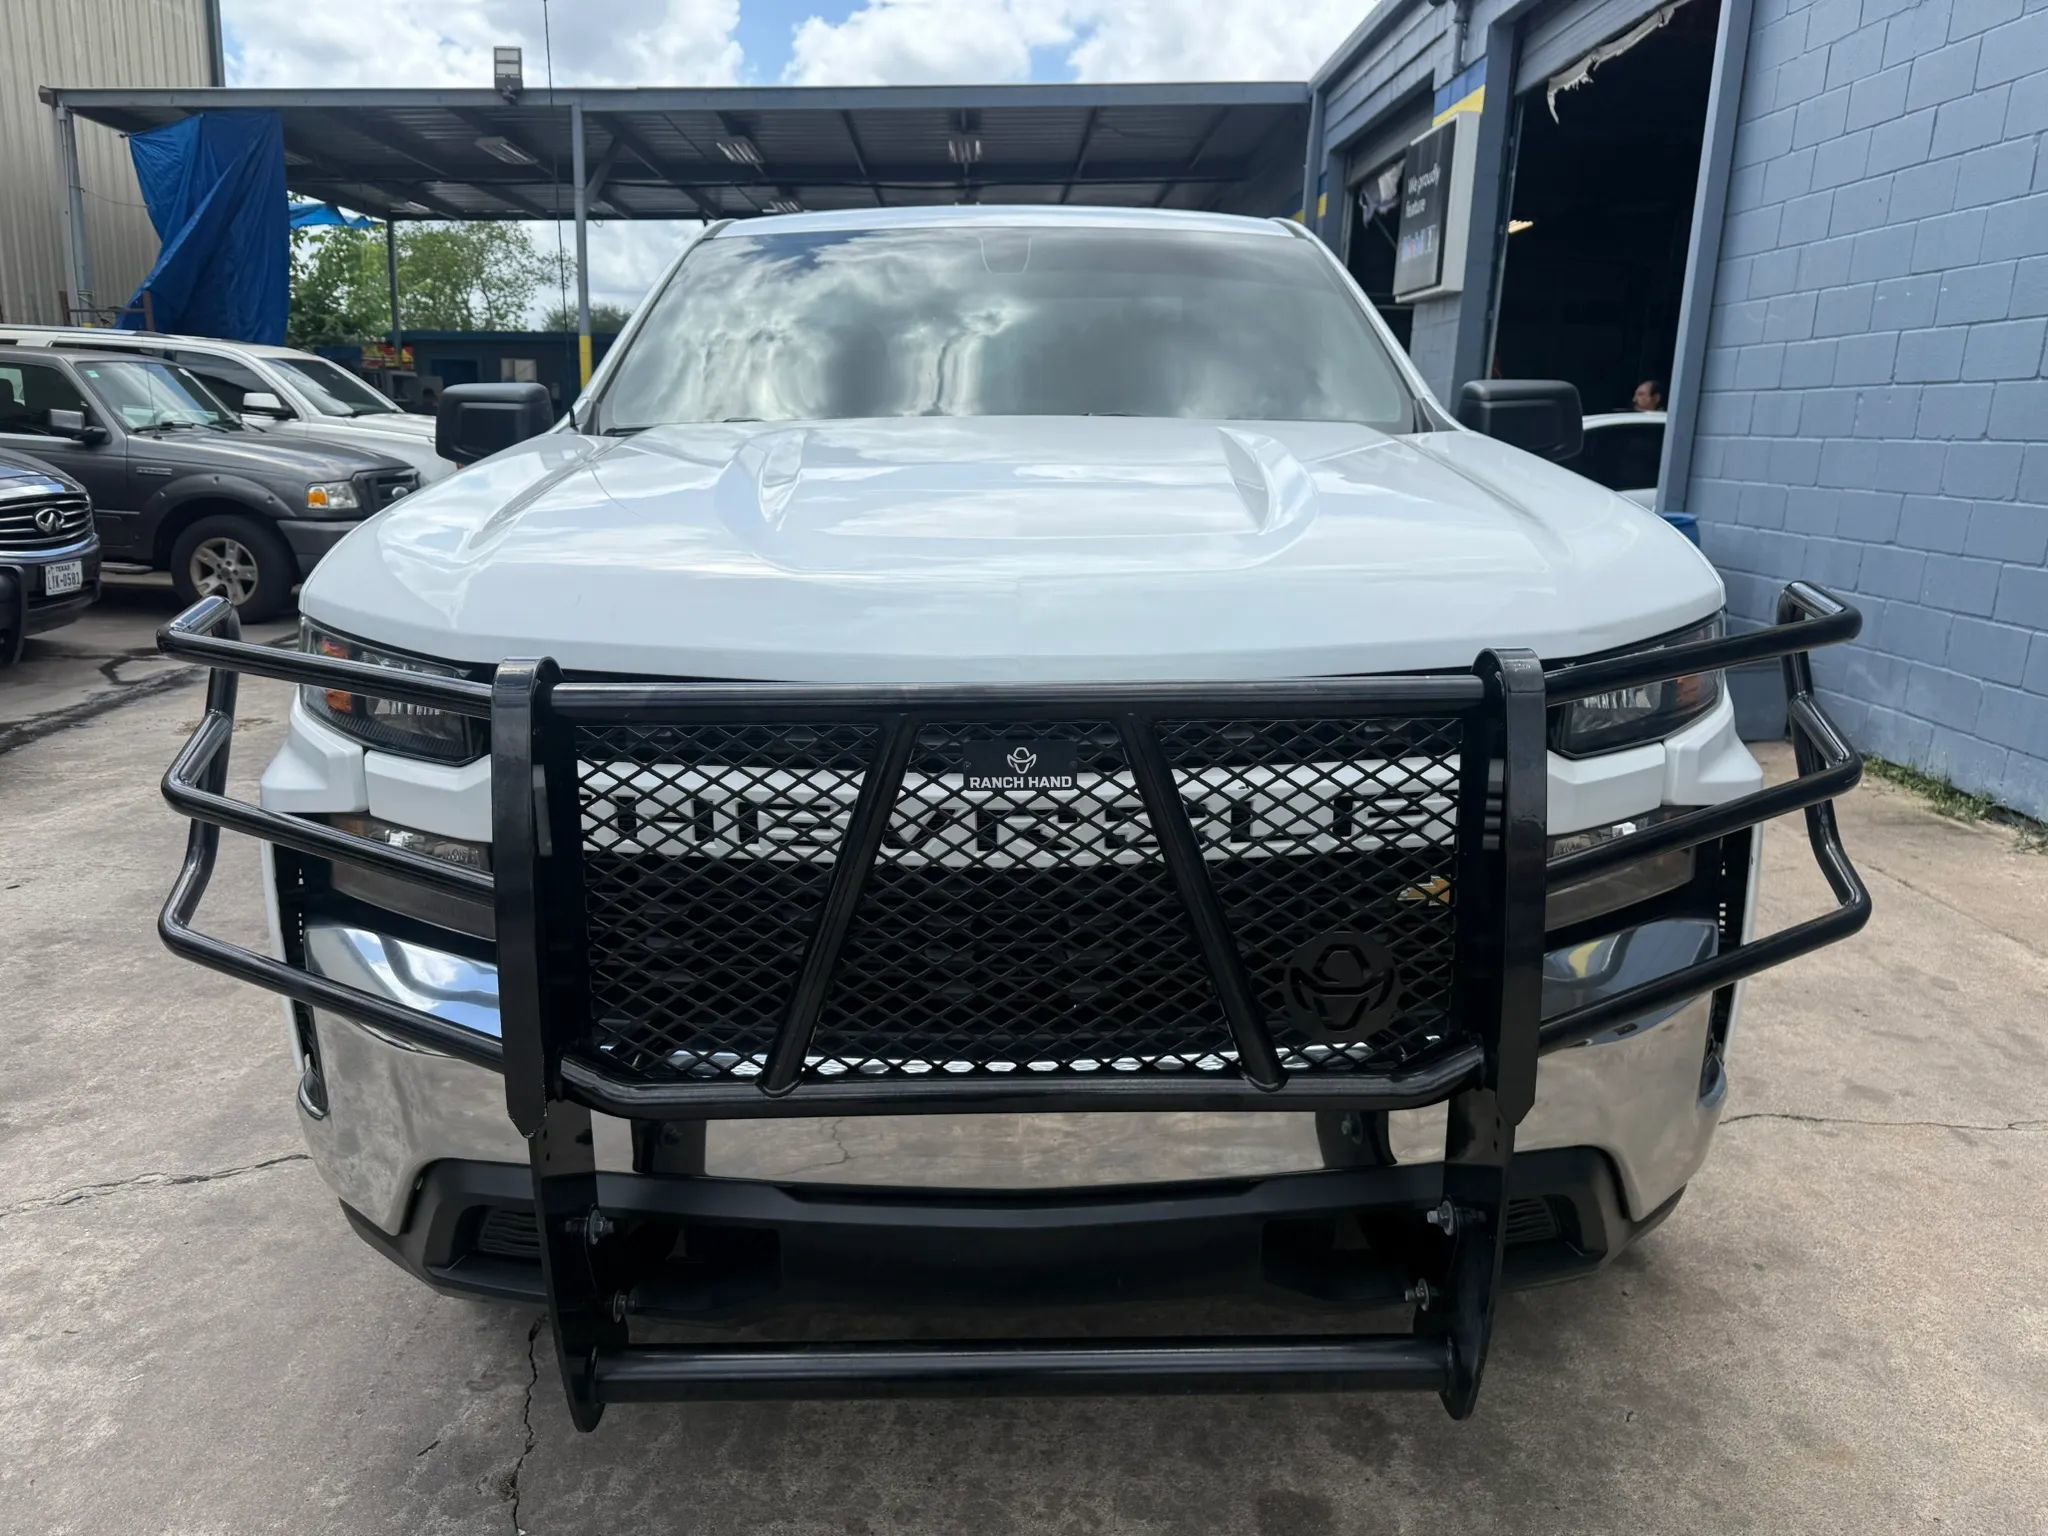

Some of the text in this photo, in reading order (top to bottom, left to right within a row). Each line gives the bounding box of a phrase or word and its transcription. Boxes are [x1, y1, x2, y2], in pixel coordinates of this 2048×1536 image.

[1417, 163, 1441, 196] proudly
[55, 564, 71, 573] TEXAS
[969, 775, 1073, 789] RANCH HAND
[580, 788, 1459, 852] HEVROLE
